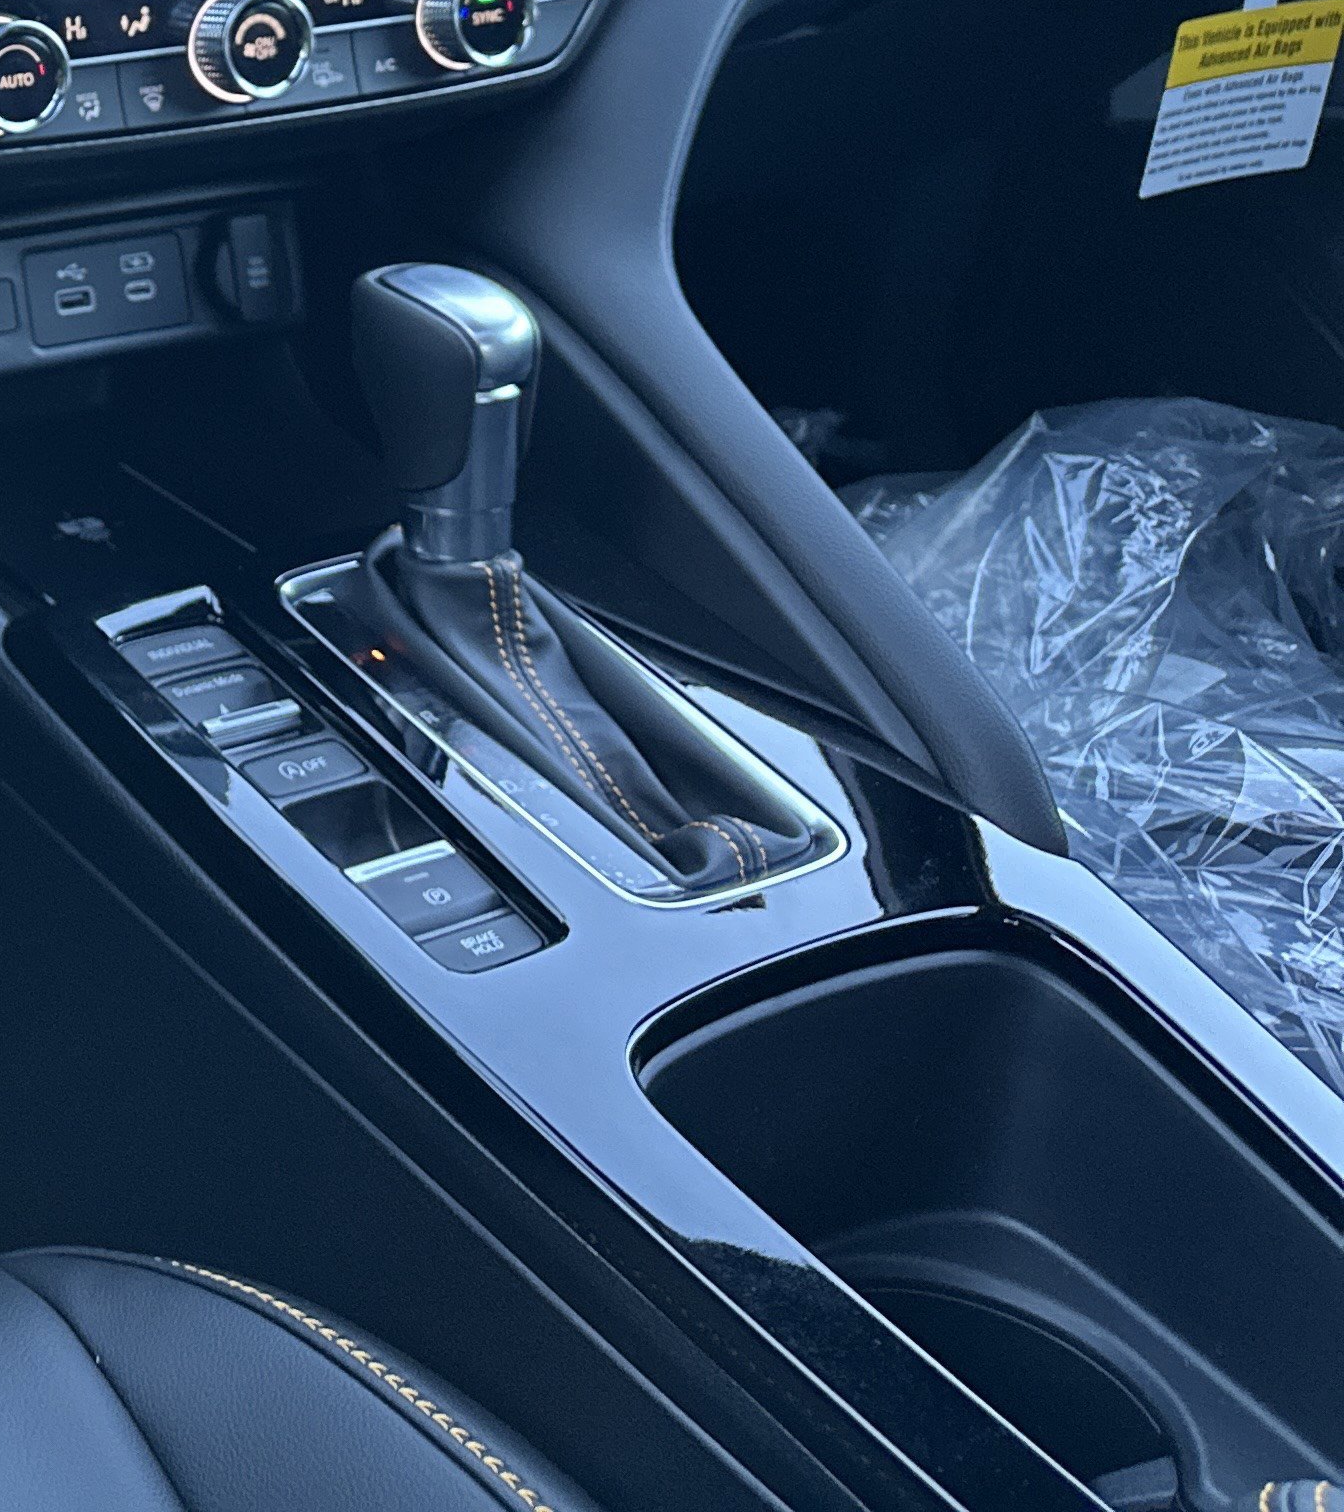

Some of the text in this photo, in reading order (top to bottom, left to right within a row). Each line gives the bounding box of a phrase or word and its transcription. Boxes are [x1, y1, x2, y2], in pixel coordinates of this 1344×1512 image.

[1257, 12, 1313, 37] Equipped
[1254, 41, 1271, 58] Air
[0, 72, 35, 90] AUTO
